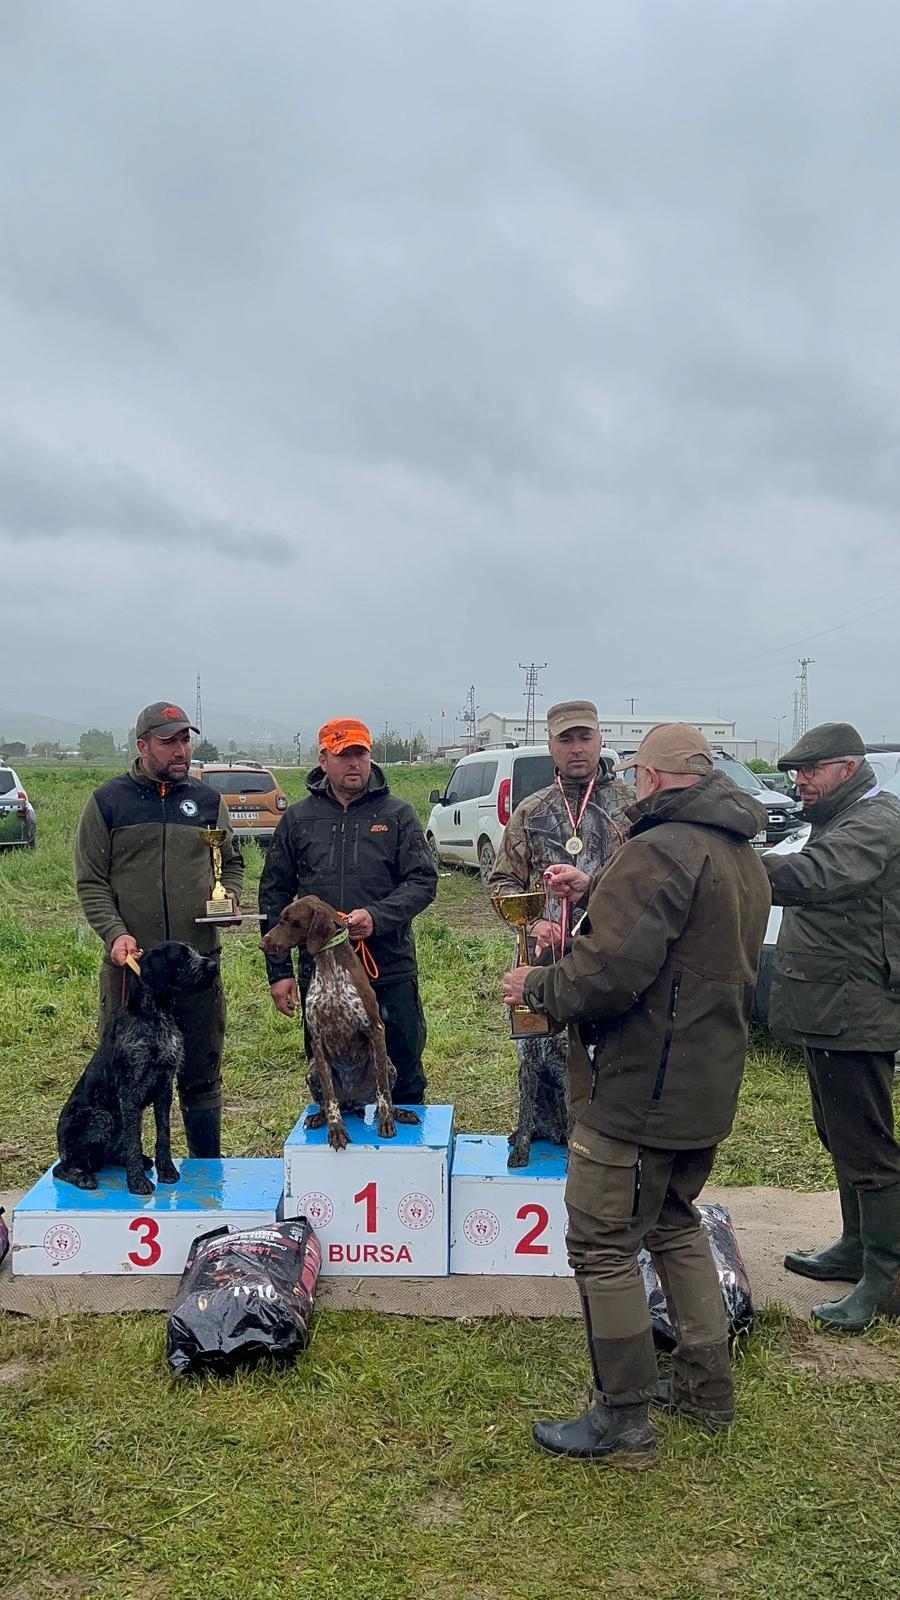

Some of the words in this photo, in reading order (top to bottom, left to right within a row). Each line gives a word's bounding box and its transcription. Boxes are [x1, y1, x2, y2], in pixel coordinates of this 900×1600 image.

[354, 1182, 377, 1233] 1
[515, 1203, 549, 1254] 2
[128, 1217, 162, 1267] 3
[328, 1244, 412, 1263] BURSA
